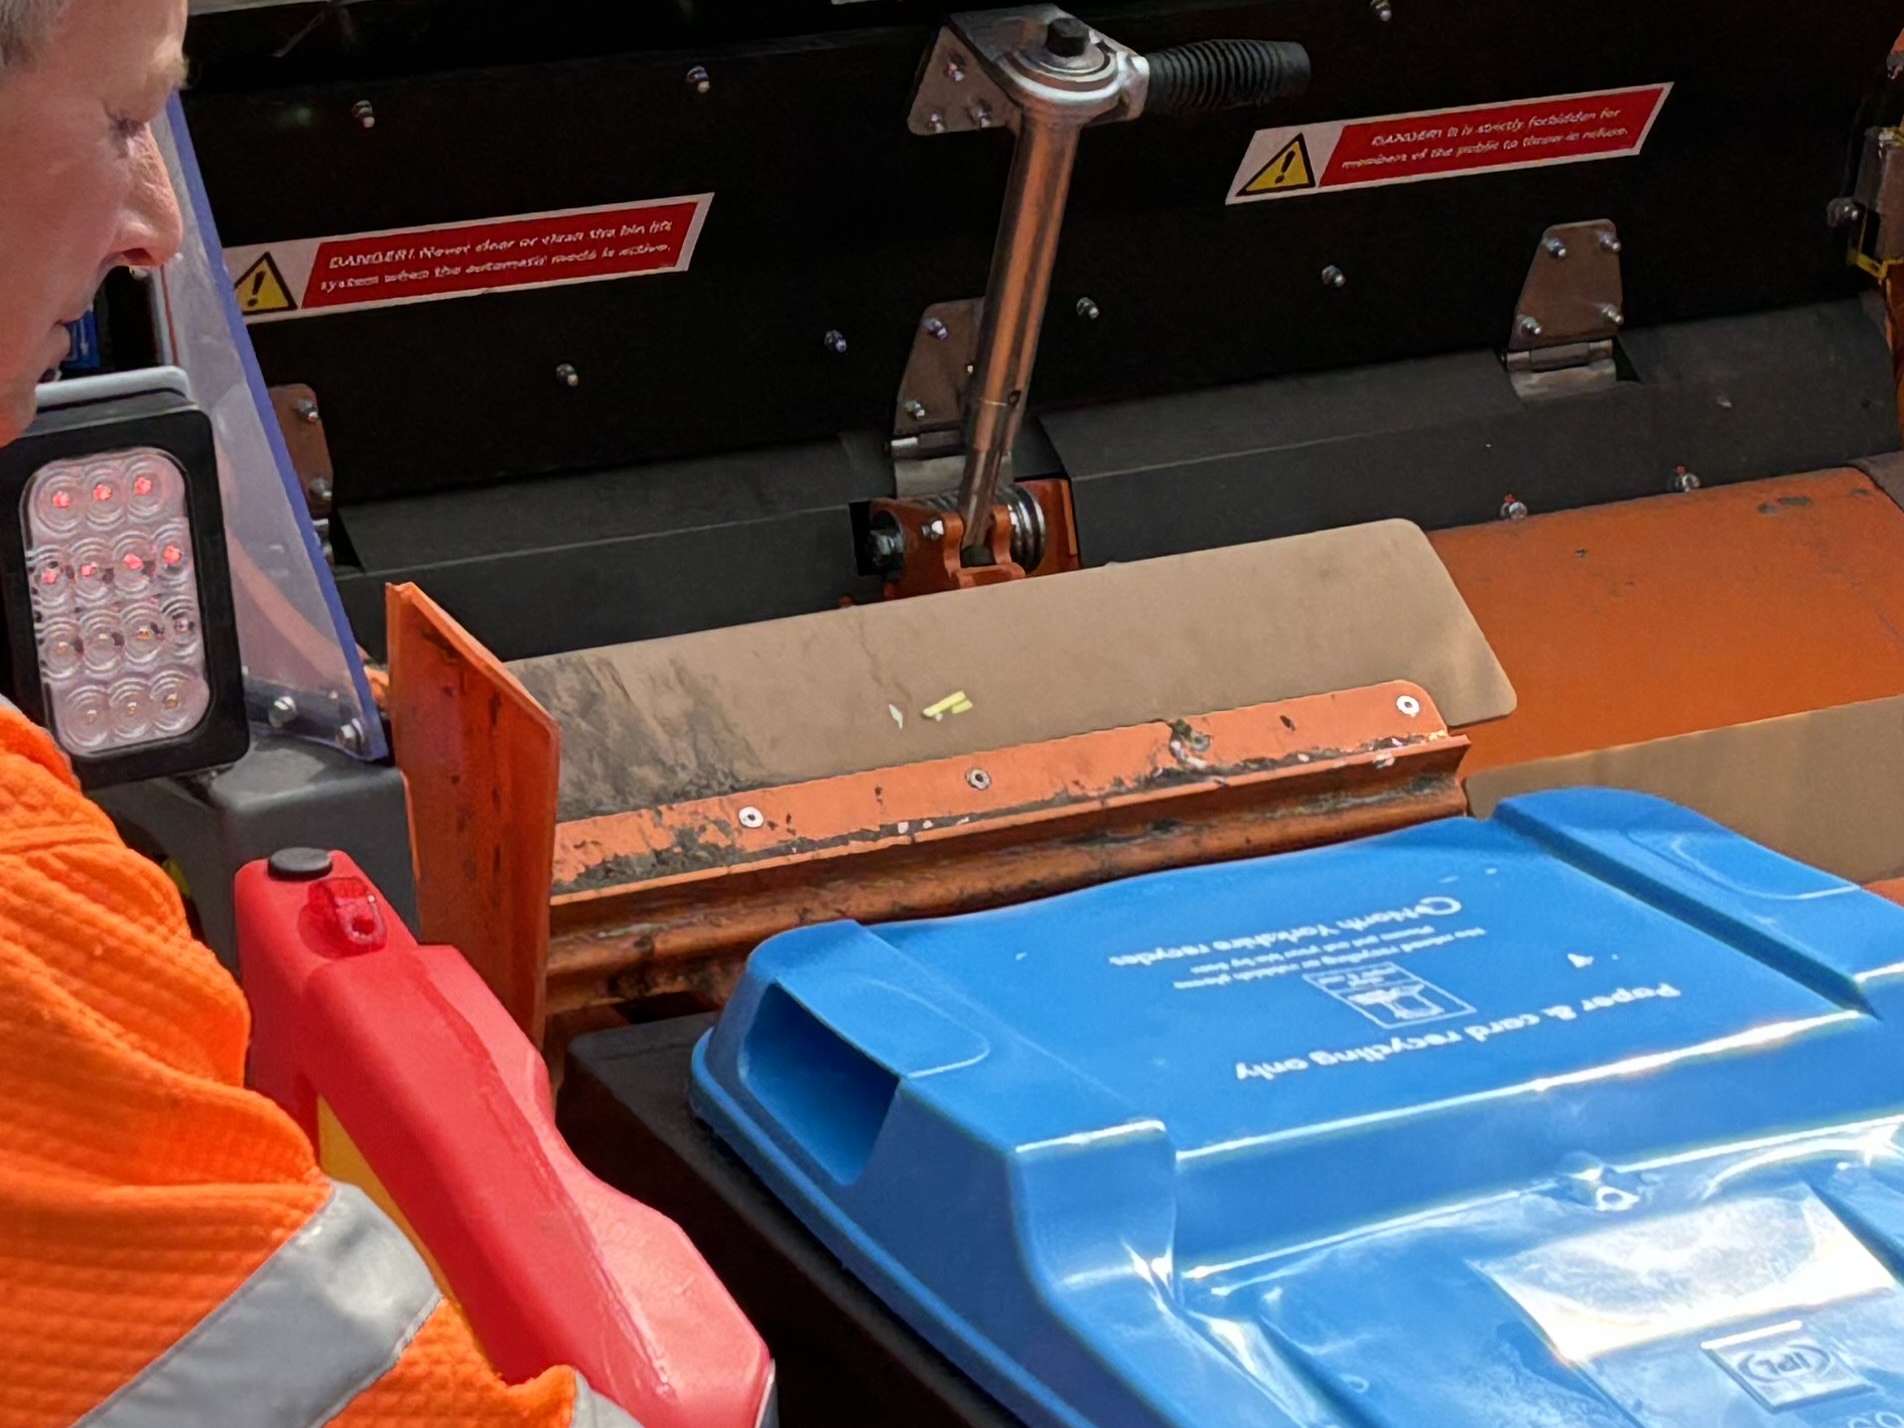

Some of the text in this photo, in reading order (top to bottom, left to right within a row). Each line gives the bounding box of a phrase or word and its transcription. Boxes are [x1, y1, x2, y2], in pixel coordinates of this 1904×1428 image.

[1528, 111, 1597, 129] forbidden
[329, 248, 416, 269] DANGER!
[420, 244, 470, 259] Never
[434, 264, 462, 278] the
[1212, 922, 1341, 952] Yorkshire
[1108, 943, 1211, 967] recycles
[1235, 981, 1682, 1081] Paper & card recycling only
